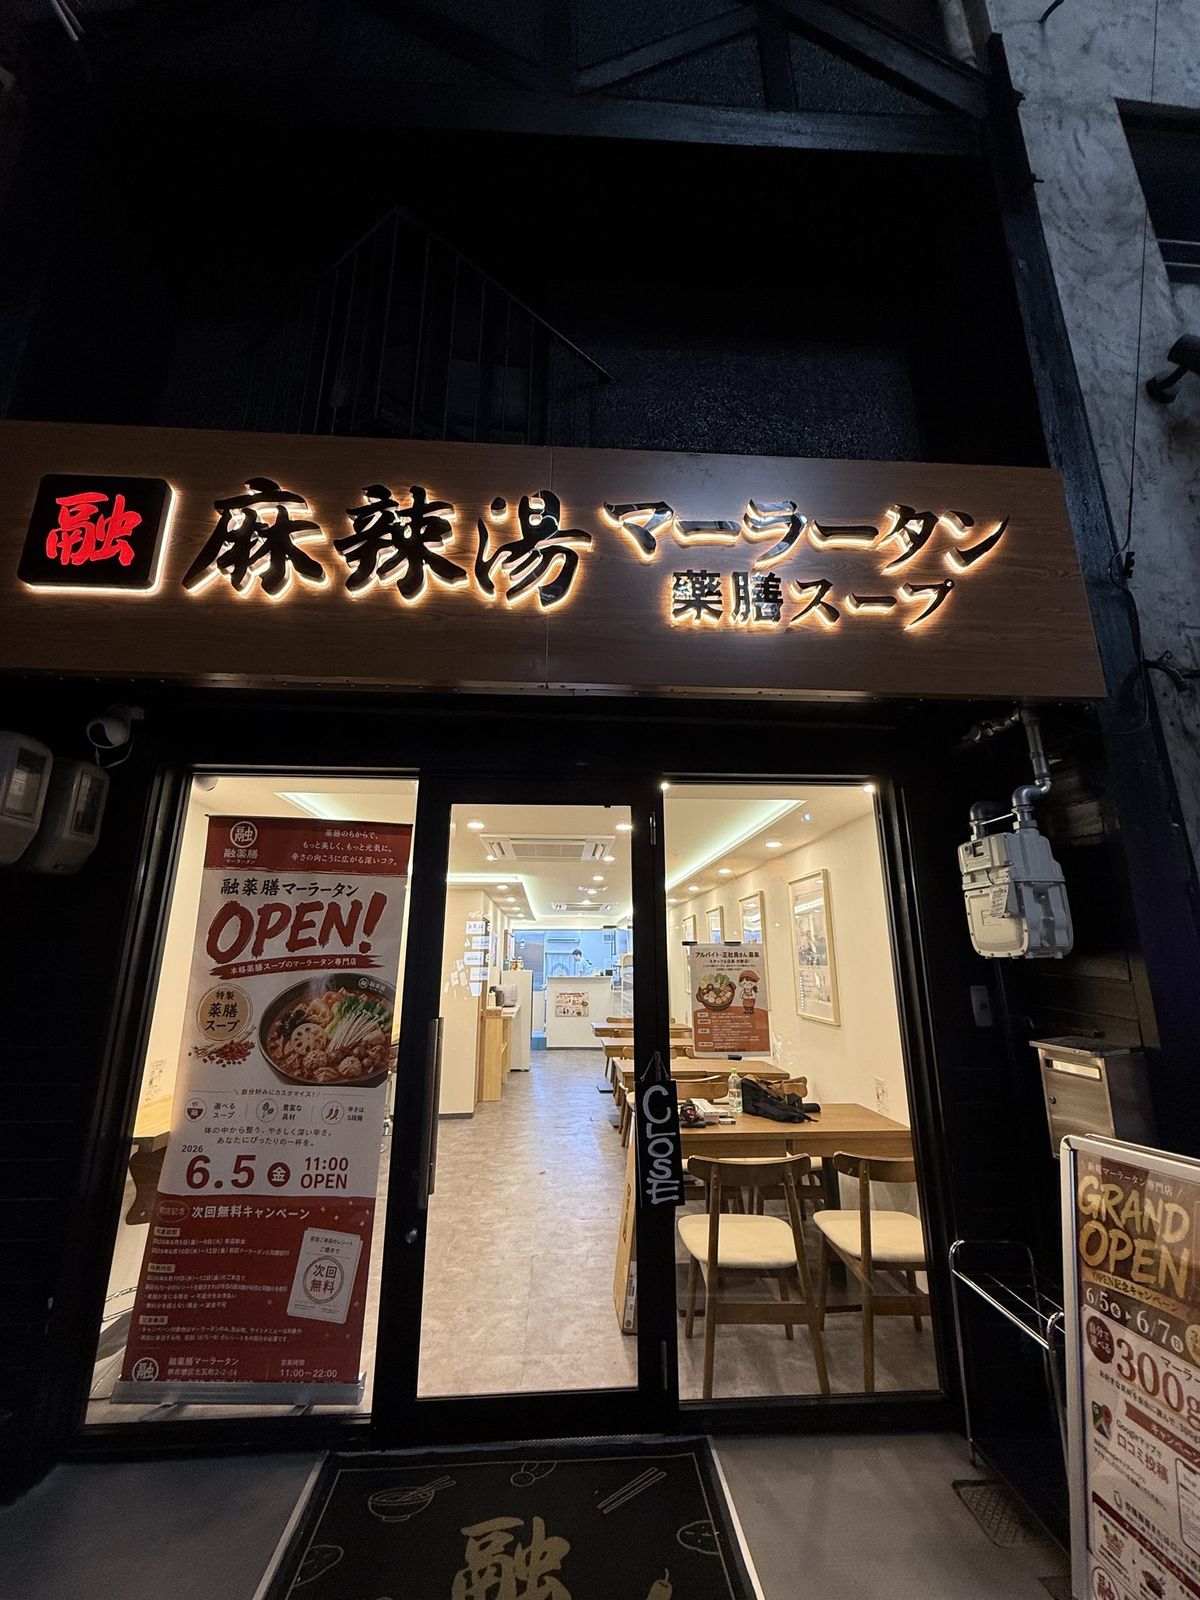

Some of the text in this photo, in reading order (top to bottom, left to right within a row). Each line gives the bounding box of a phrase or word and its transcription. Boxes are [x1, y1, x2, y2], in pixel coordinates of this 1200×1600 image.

[46, 491, 142, 566] 融
[182, 477, 1010, 608] 麻辣湯 マーラータン
[234, 826, 254, 842] 融
[220, 878, 359, 898] 融薬膳マーラータン
[206, 891, 387, 964] OPEN!
[230, 958, 357, 975] 本格薬膳スープのマーラータン専門店
[215, 989, 234, 1000] 特製
[208, 1003, 239, 1018] 薬膳
[204, 1019, 240, 1033] スープ
[213, 1102, 236, 1110] 選べる
[282, 1104, 303, 1112] 豊富な
[212, 1111, 236, 1119] スープ
[181, 1145, 204, 1153] 2026
[216, 1137, 315, 1147] あなたにぴったりの一杯を。
[642, 1085, 680, 1205] CLOSE
[185, 1154, 287, 1189] 6.5 金
[304, 1156, 349, 1172] 11:00
[300, 1173, 349, 1190] OPEN
[191, 1204, 310, 1220] 次回無料キャンペーン
[1078, 1175, 1189, 1243] GRAND
[1079, 1220, 1190, 1298] OPEN
[313, 1264, 338, 1279] 次回
[310, 1278, 335, 1294] 無料
[1136, 1309, 1171, 1345] 6/7
[136, 1362, 155, 1379] 融
